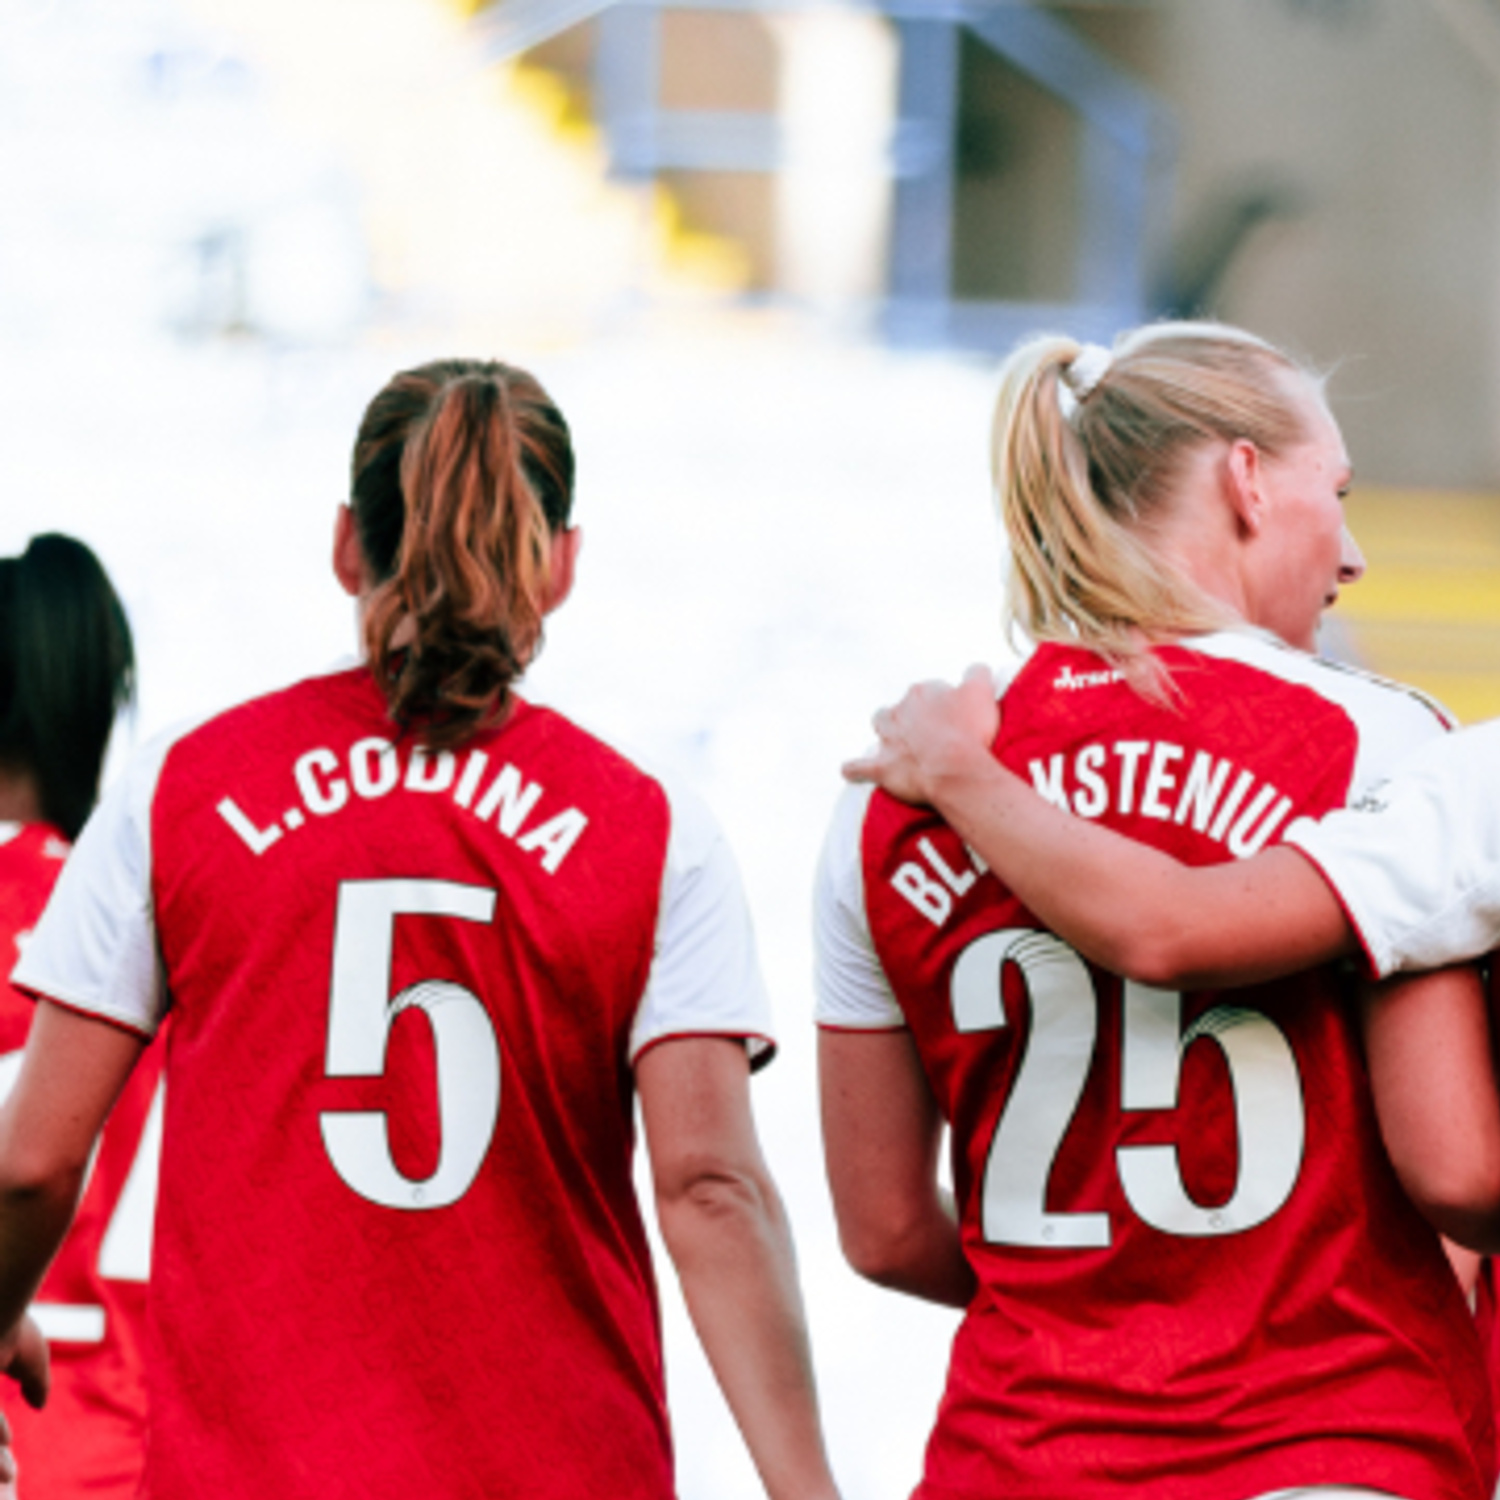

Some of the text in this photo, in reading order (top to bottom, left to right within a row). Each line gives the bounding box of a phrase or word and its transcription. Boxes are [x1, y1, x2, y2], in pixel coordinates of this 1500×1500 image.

[215, 736, 588, 875] L.CODINA
[318, 877, 500, 1210] 5
[950, 928, 1305, 1249] 25
